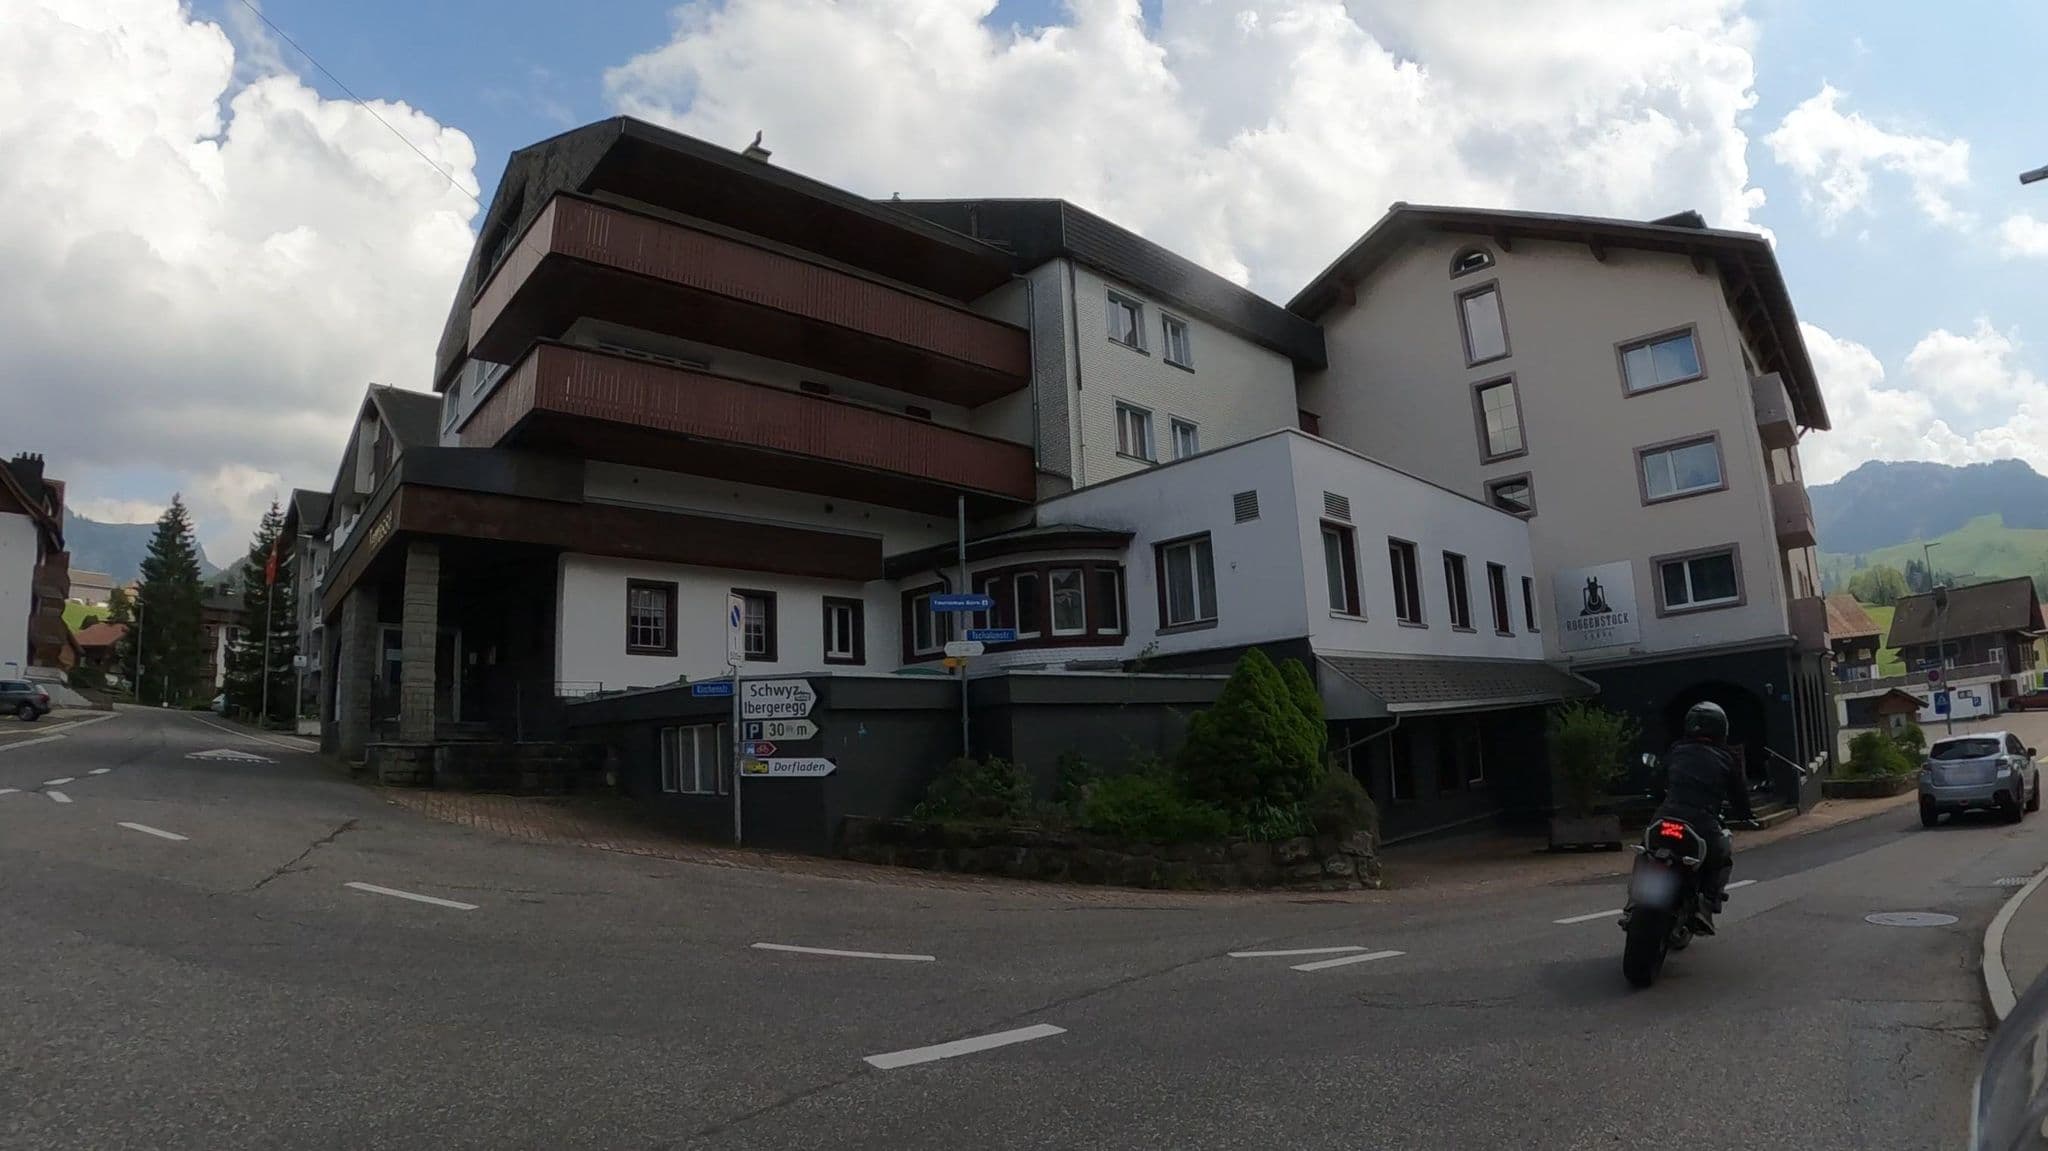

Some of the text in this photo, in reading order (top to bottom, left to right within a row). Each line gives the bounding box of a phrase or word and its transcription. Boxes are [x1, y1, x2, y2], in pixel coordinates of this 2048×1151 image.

[1566, 613, 1629, 631] ROGGENSTOCK
[751, 683, 798, 699] Schwyz
[744, 701, 806, 716] Ibergeregg
[769, 723, 784, 737] 30
[797, 725, 807, 735] m
[774, 761, 825, 773] Dorfladen
